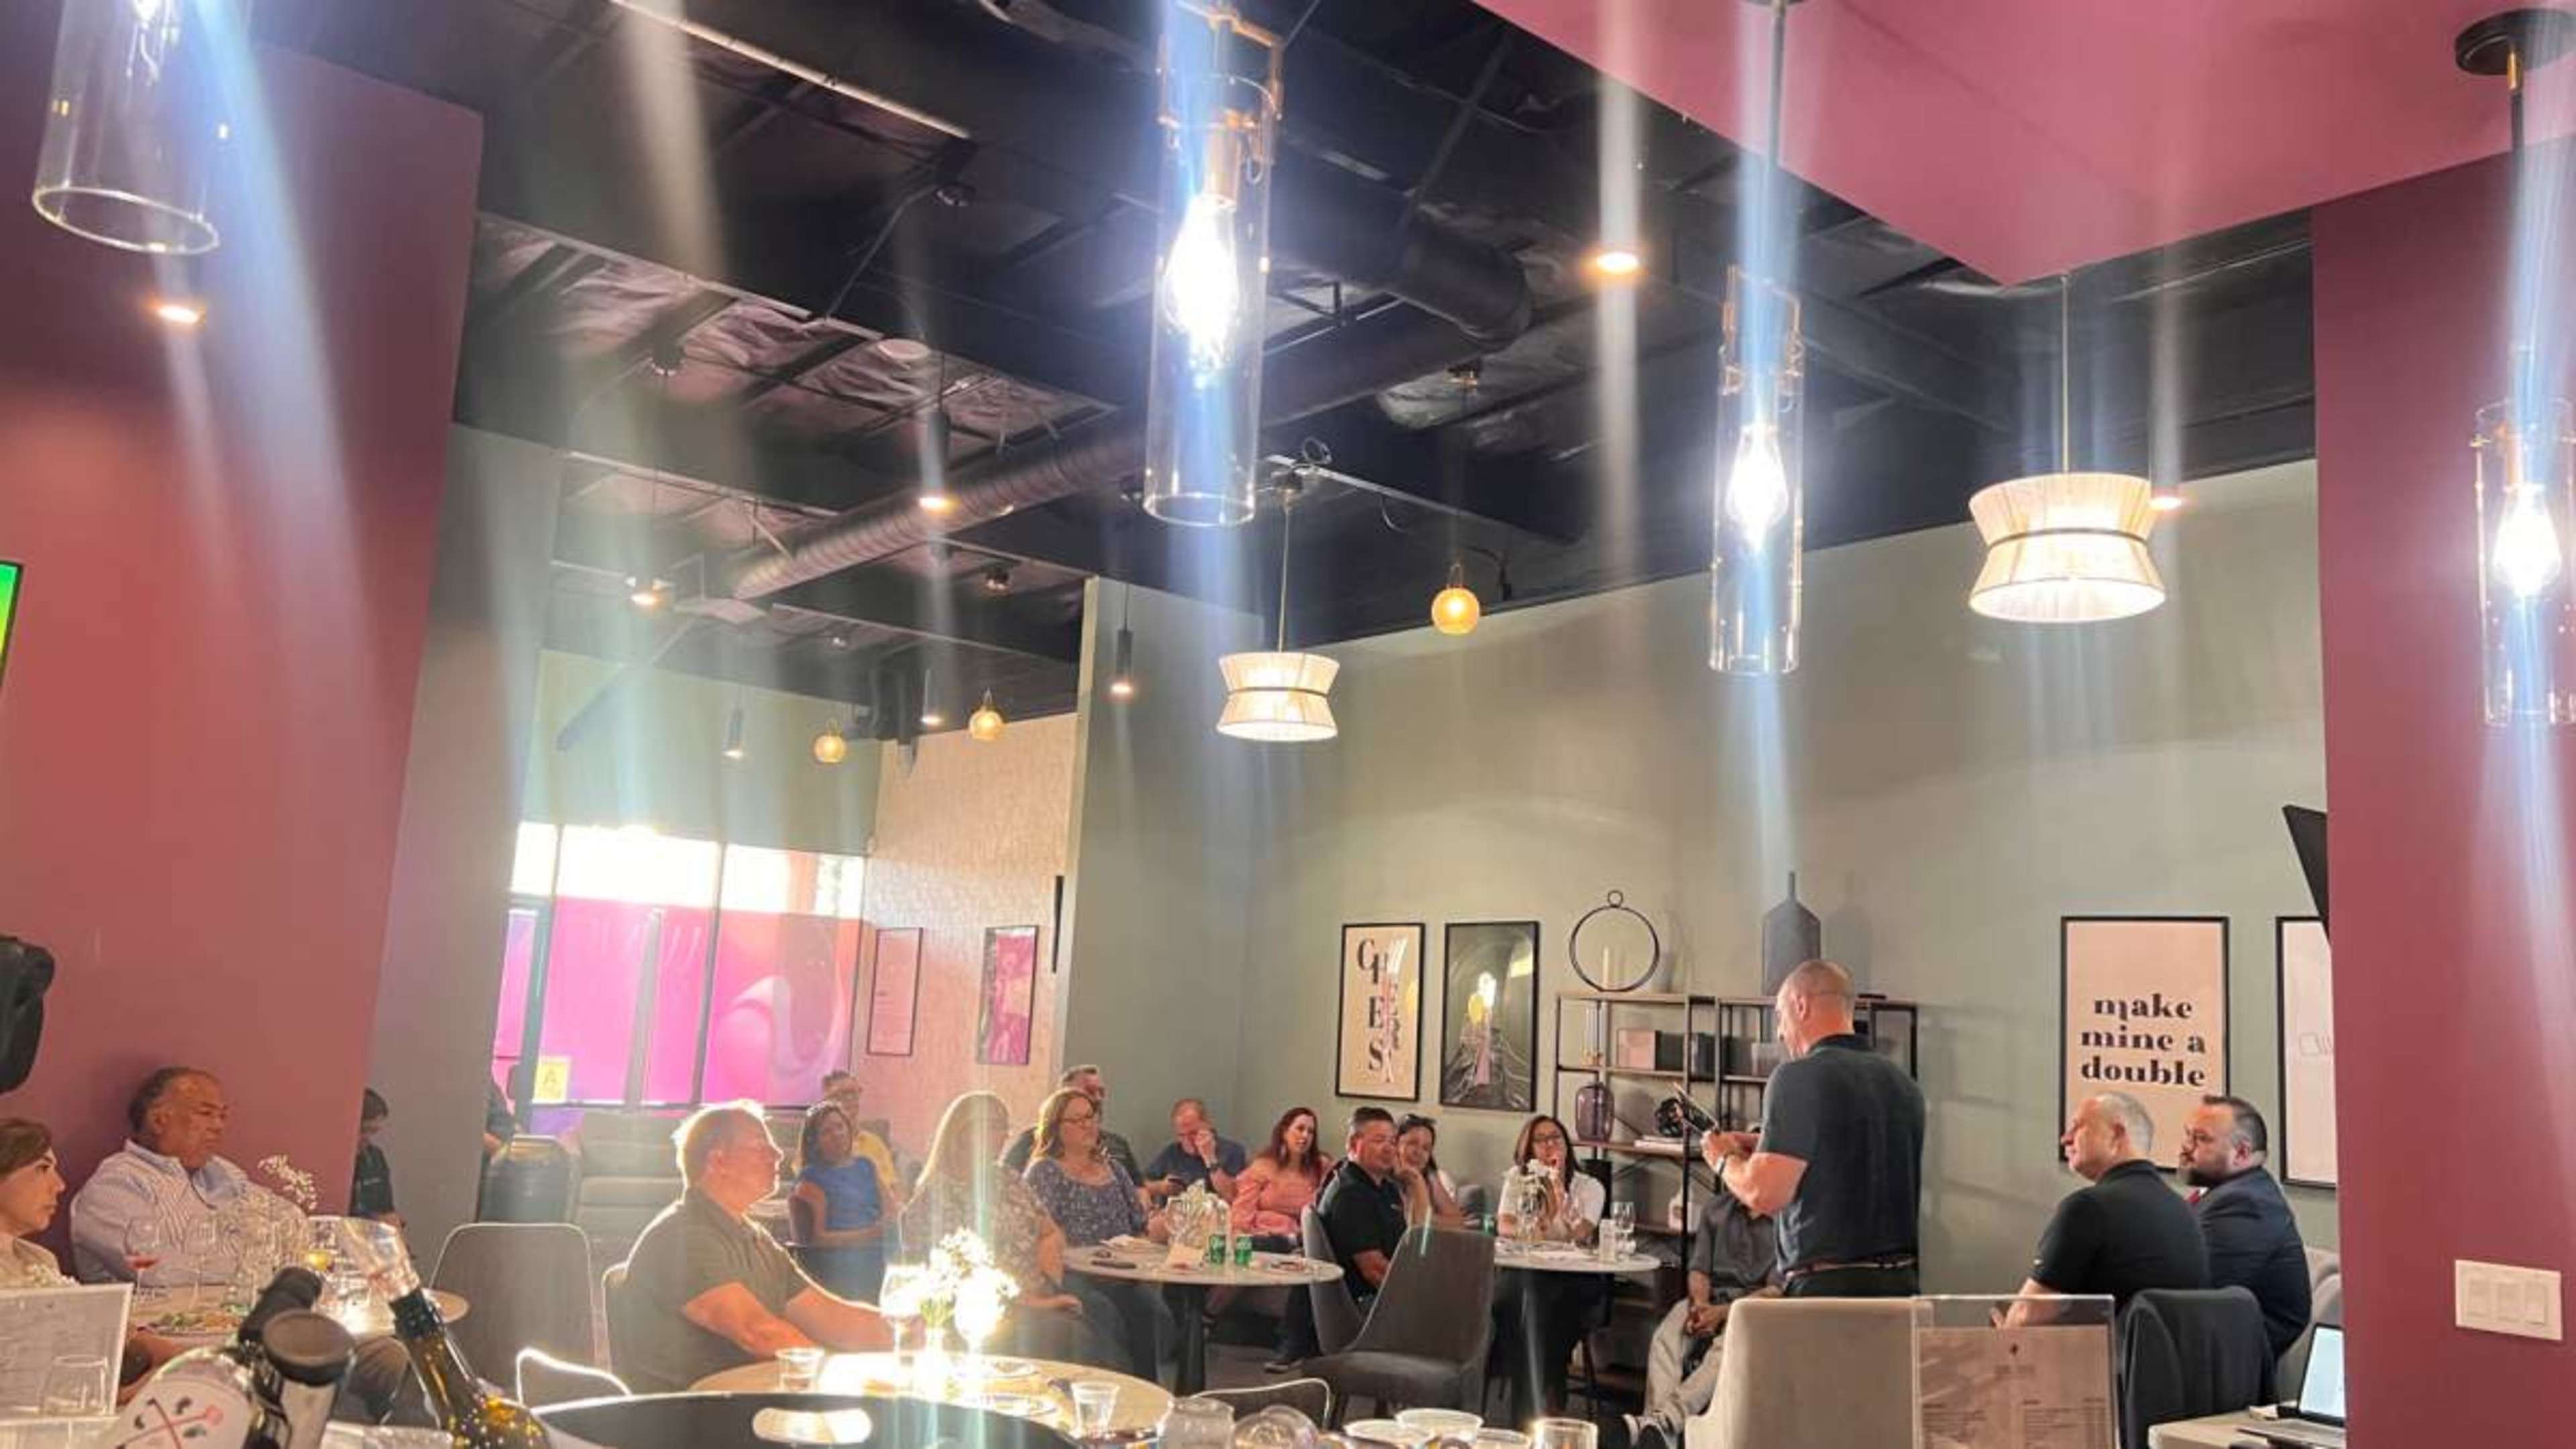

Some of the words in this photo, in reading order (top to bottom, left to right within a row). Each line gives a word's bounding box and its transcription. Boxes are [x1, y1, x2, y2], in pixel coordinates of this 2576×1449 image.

[2094, 993, 2192, 1022] make
[2081, 1024, 2174, 1052] mine
[2187, 1036, 2206, 1054] a
[2081, 1055, 2205, 1087] double
